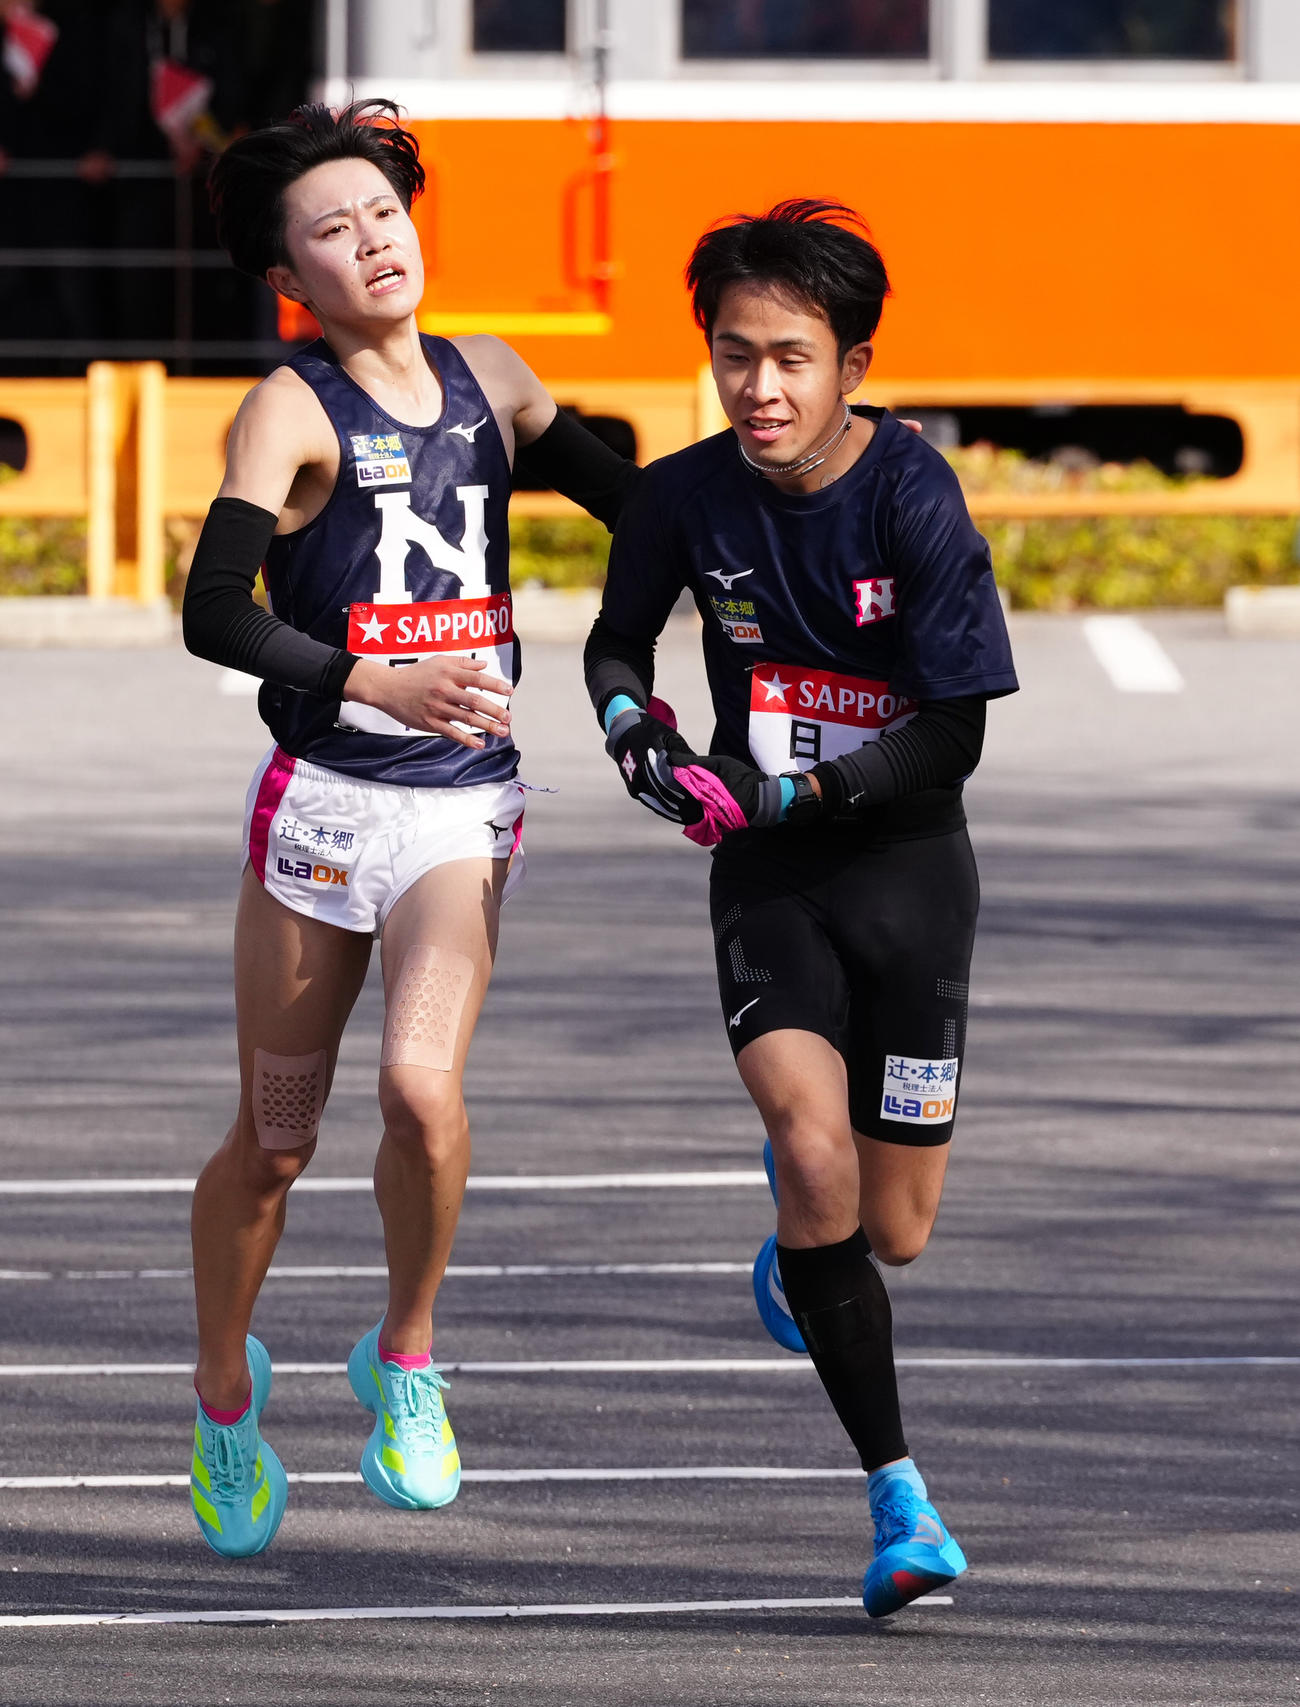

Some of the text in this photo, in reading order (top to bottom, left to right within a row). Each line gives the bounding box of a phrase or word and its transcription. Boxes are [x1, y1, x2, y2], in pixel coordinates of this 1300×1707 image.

[373, 485, 491, 604] N
[854, 577, 897, 625] N
[395, 606, 509, 644] SAPPORO
[798, 680, 909, 719] SAPPO
[277, 857, 349, 886] Laox
[883, 1094, 954, 1118] Laox
[902, 1082, 943, 1093] 税理士法人
